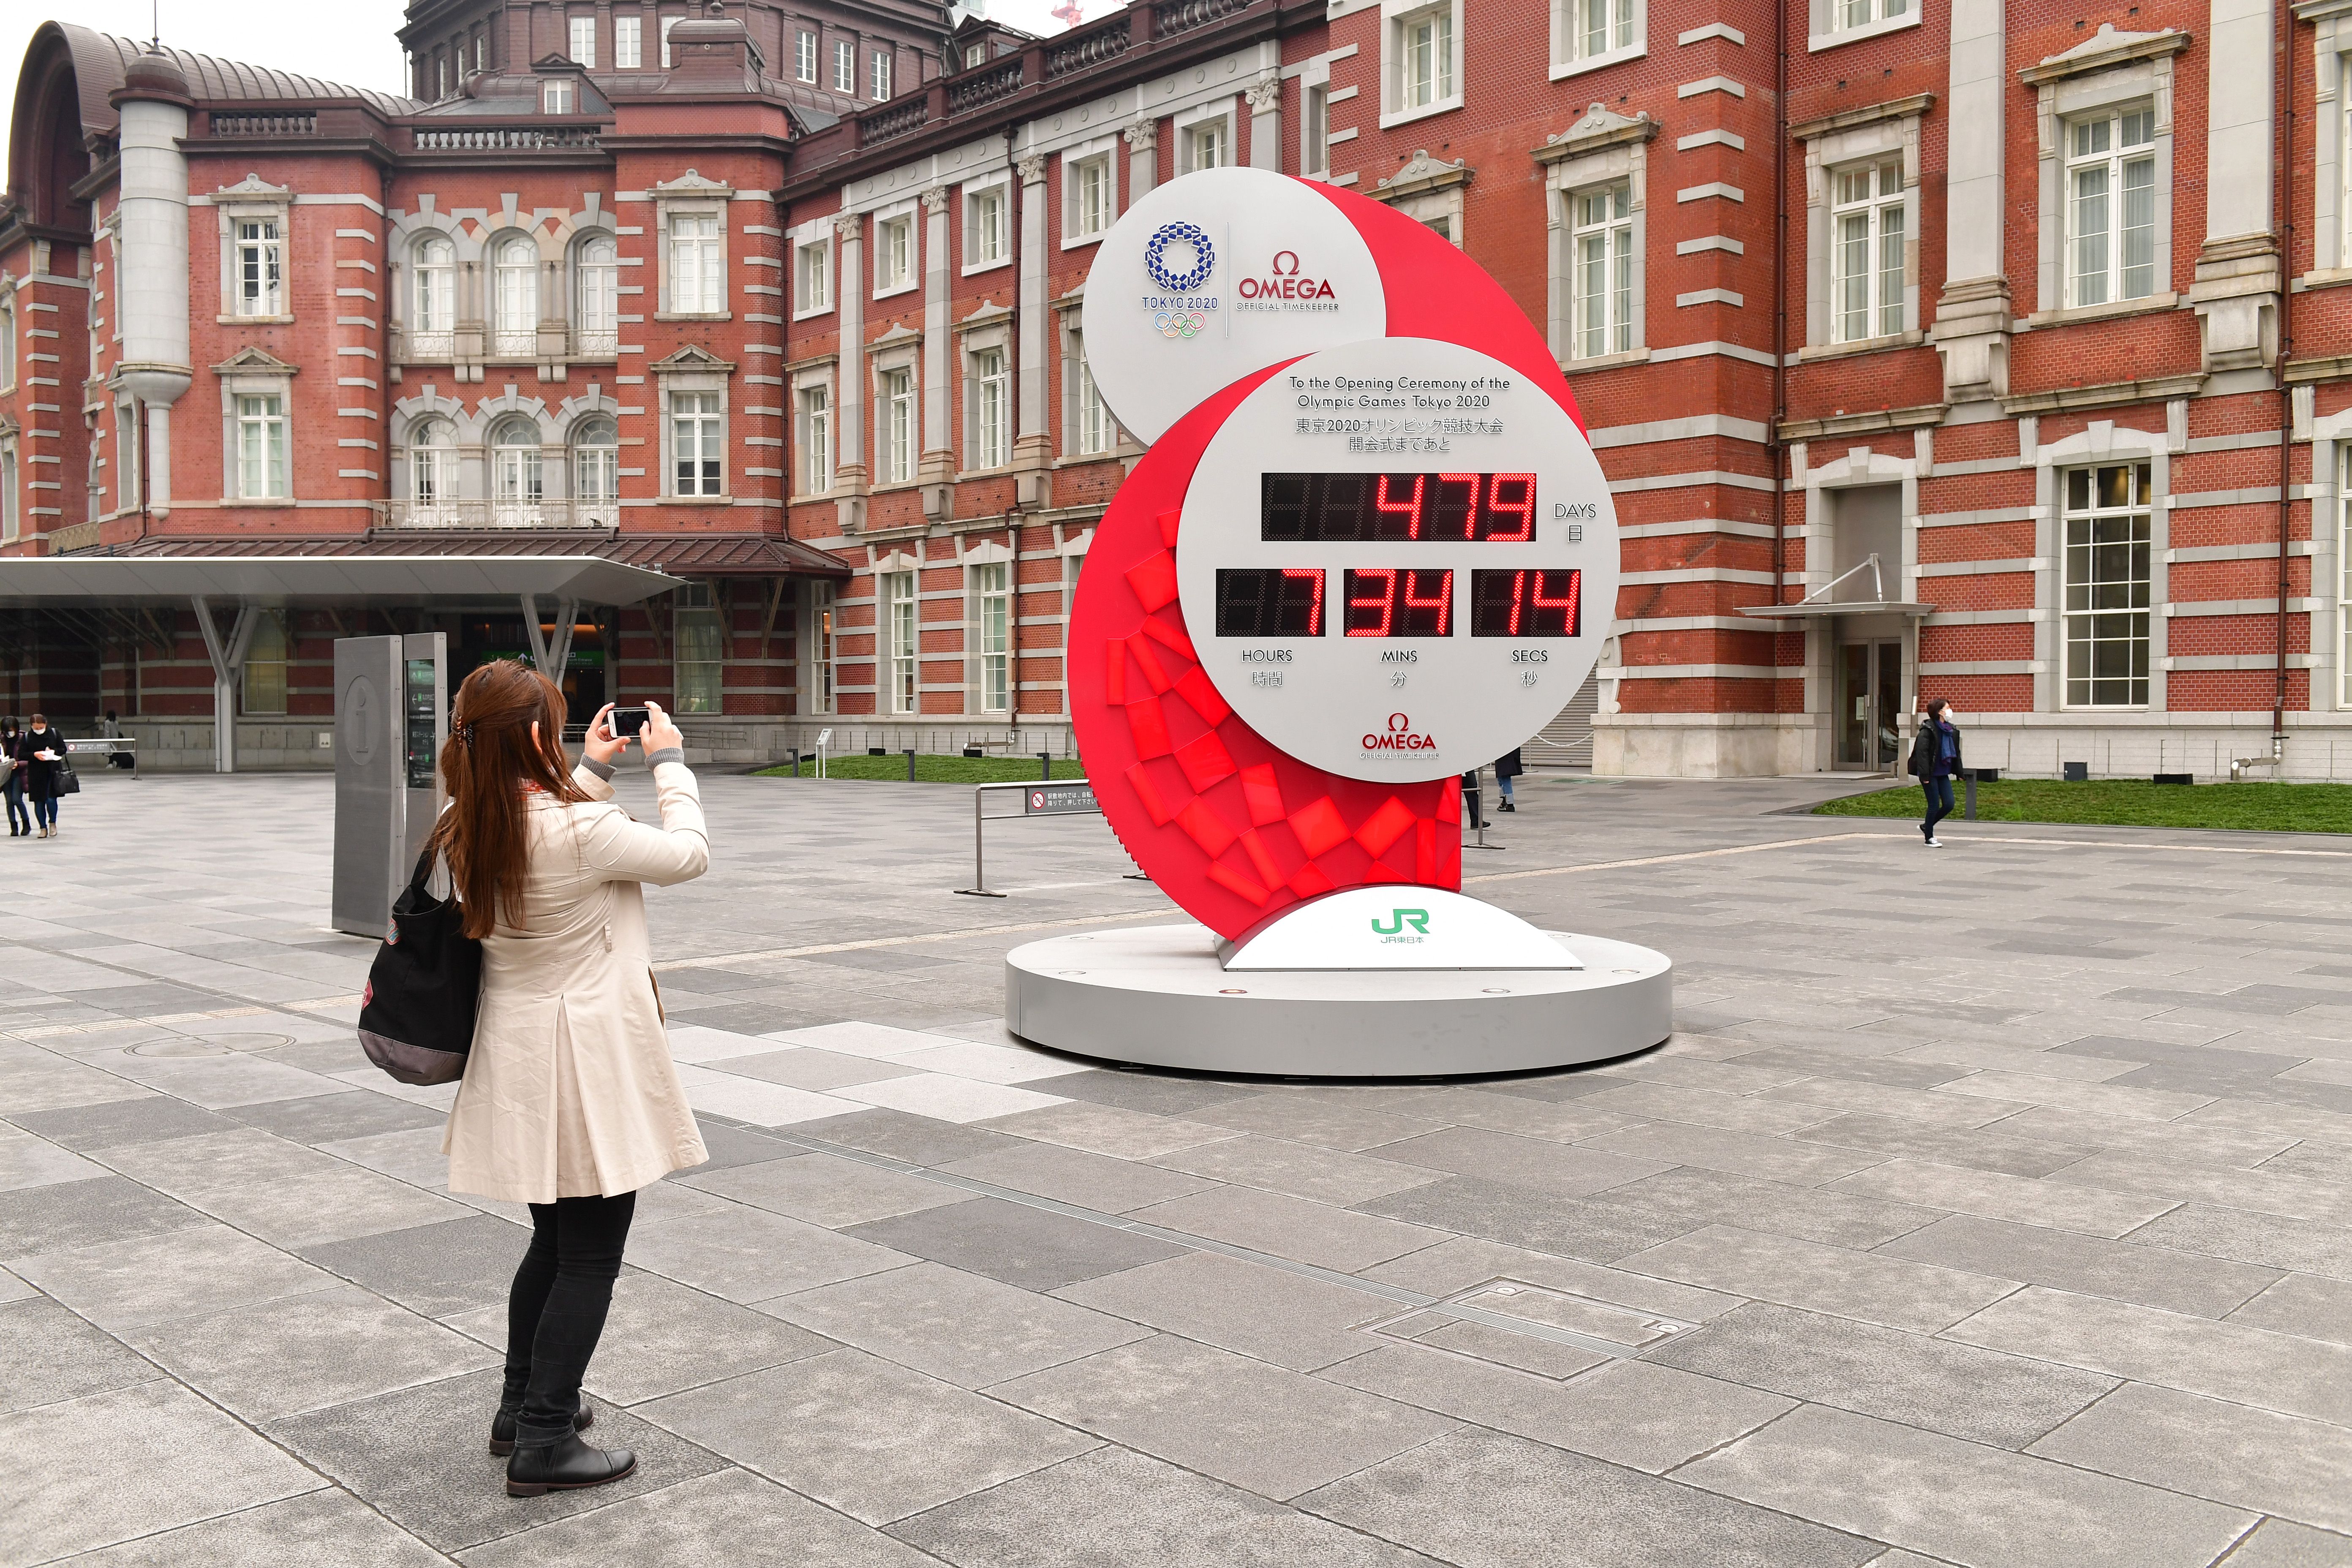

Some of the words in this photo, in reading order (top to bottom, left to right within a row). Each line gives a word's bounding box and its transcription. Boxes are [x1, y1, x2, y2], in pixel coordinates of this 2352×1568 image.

[1239, 278, 1335, 299] OMEGA
[1142, 297, 1184, 310] TOKYO
[1187, 297, 1218, 310] 2020
[1236, 302, 1279, 311] OFFICIAL
[1282, 303, 1338, 311] TIMEKEEPER
[1289, 376, 1304, 390] To
[1308, 377, 1330, 390] the
[1334, 377, 1392, 393] Opening
[1397, 376, 1466, 393] Ceremony
[1470, 377, 1484, 390] of
[1488, 377, 1510, 390] the
[1297, 395, 1354, 411] Olympic
[1358, 395, 1405, 409] Games
[1411, 395, 1451, 412] Tokyo
[1455, 395, 1489, 408] 2020
[1295, 418, 1503, 434] 東京2020オリンピック競技大会
[1349, 436, 1450, 452] 開会式まであと
[1377, 473, 1535, 541] 479
[1554, 503, 1595, 519] DAYS
[1568, 525, 1582, 543] 日
[1283, 569, 1324, 634] 7
[1347, 569, 1451, 637] 34
[1509, 572, 1579, 634] 14
[1241, 649, 1293, 663] HOURS
[1380, 650, 1417, 663] MINS
[1511, 649, 1547, 663] SECS
[1252, 670, 1282, 687] 時間
[1391, 671, 1407, 687] 分
[1522, 670, 1538, 687] 秒
[1362, 733, 1436, 749] OMEGA
[1048, 791, 1093, 799] 駅敷地内では、自転
[1372, 909, 1430, 934] JR
